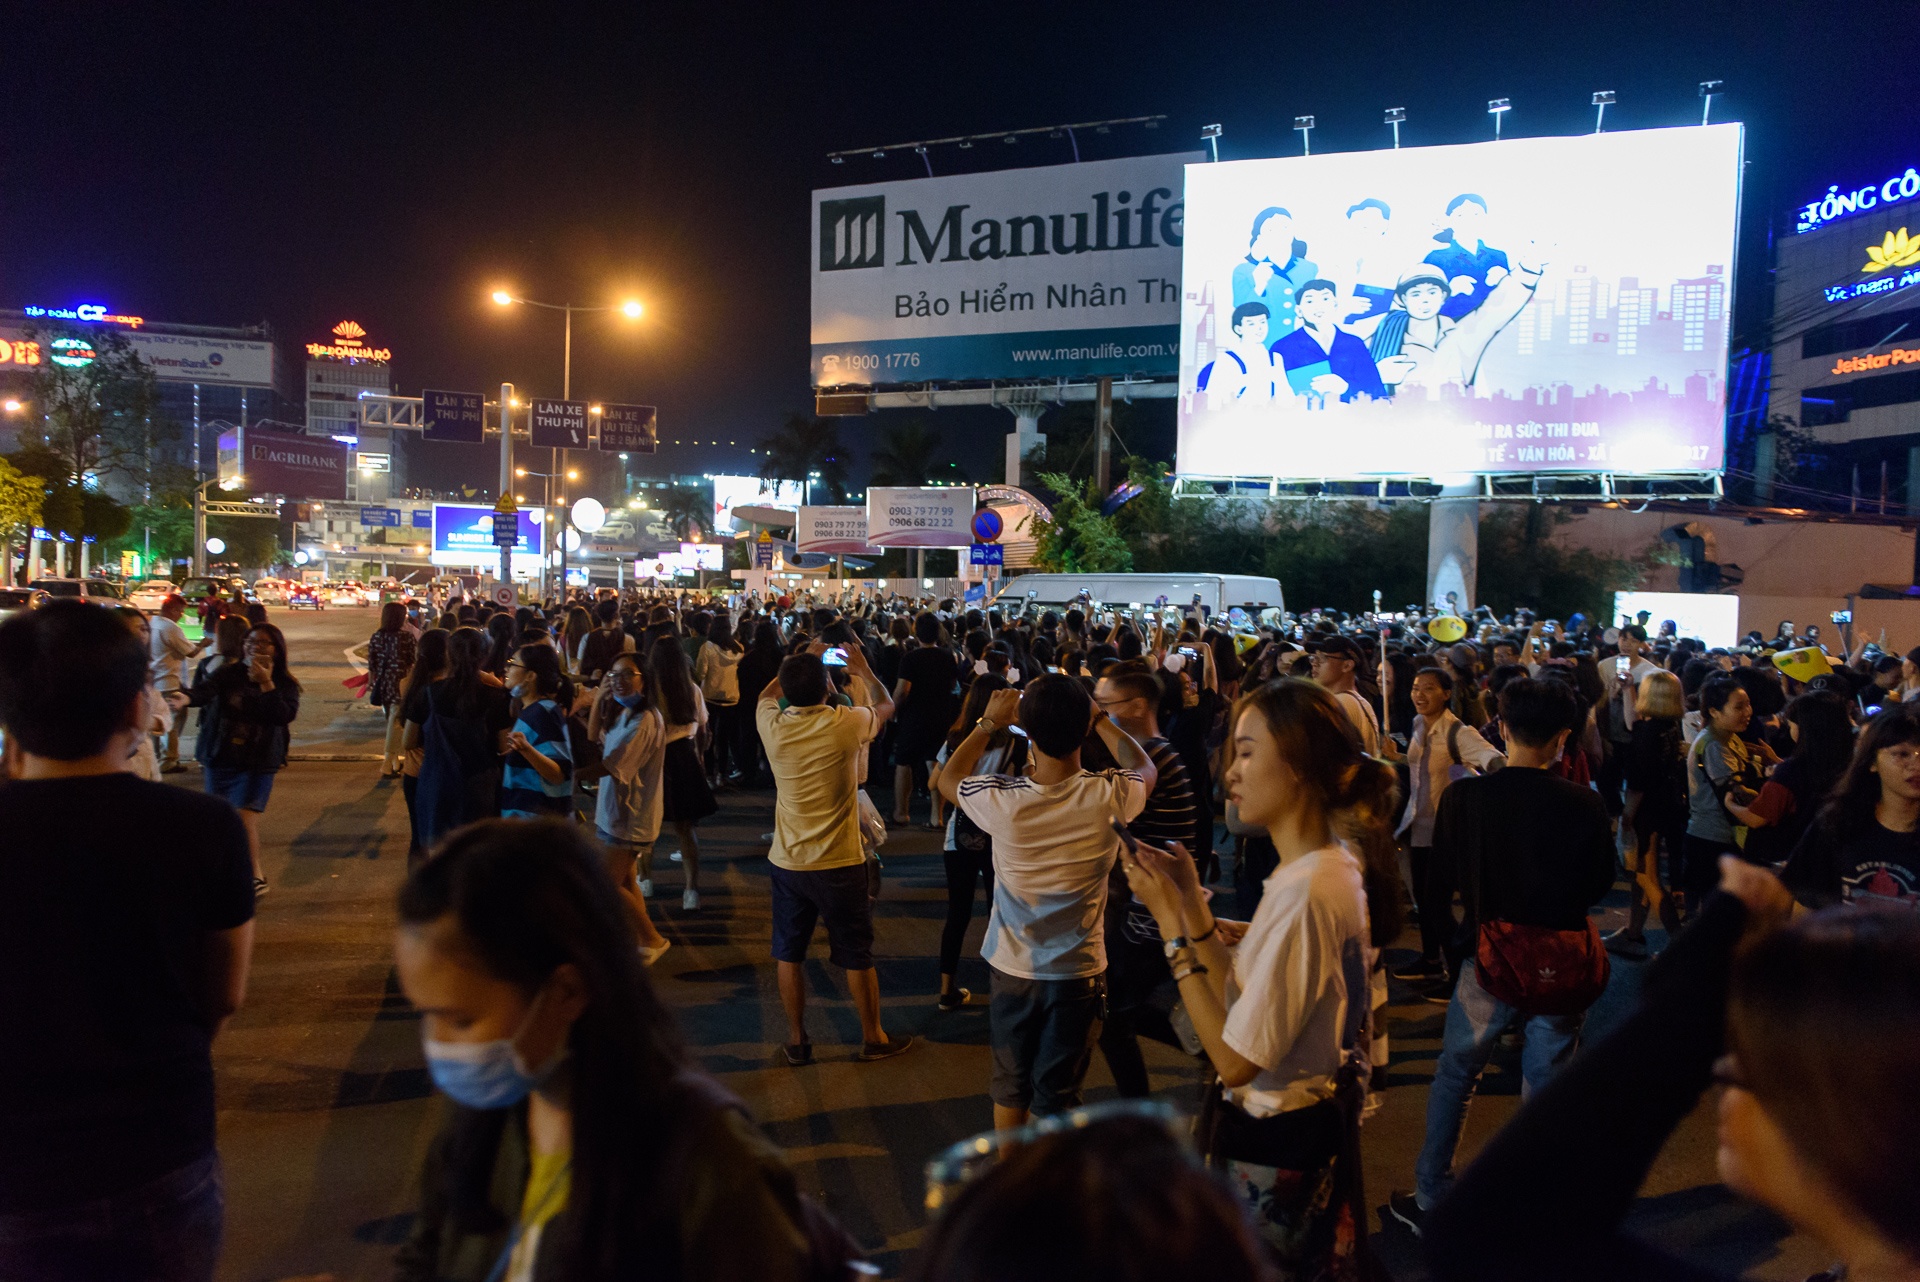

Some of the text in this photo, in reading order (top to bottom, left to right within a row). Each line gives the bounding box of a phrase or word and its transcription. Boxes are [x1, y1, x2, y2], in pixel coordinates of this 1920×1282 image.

[1805, 185, 1877, 224] TỔNG
[1881, 168, 1920, 203] CÔ
[895, 187, 1184, 267] Manulife
[894, 277, 1182, 319] Bảo Hiểm Nhân Th
[77, 304, 107, 321] CT
[149, 355, 209, 369] VietinBank
[844, 352, 921, 370] 1900 1776
[1831, 353, 1892, 375] Jetstar
[435, 394, 478, 408] LÀN XE
[435, 408, 480, 422] THU PHÍ
[538, 402, 583, 416] LÀN XE
[603, 408, 638, 421] LÀN XE
[536, 416, 584, 429] THU PHÍ
[1495, 422, 1513, 439] RA
[1516, 420, 1542, 439] SỨC
[1546, 422, 1568, 438] THI
[1572, 422, 1600, 438] ĐUA
[603, 435, 616, 444] XE
[618, 436, 624, 445] 2
[1488, 442, 1508, 462] TẾ
[1517, 444, 1544, 462] VĂN
[1548, 443, 1576, 462] HÓA
[1587, 443, 1607, 461] XÃ
[268, 451, 338, 469] AGRIBANK
[889, 506, 954, 516] 0903 79 77 99
[814, 520, 867, 529] 0903 79 77 99
[889, 517, 954, 527] 0906 68 22 22
[814, 530, 866, 538] 0906 68 22 22
